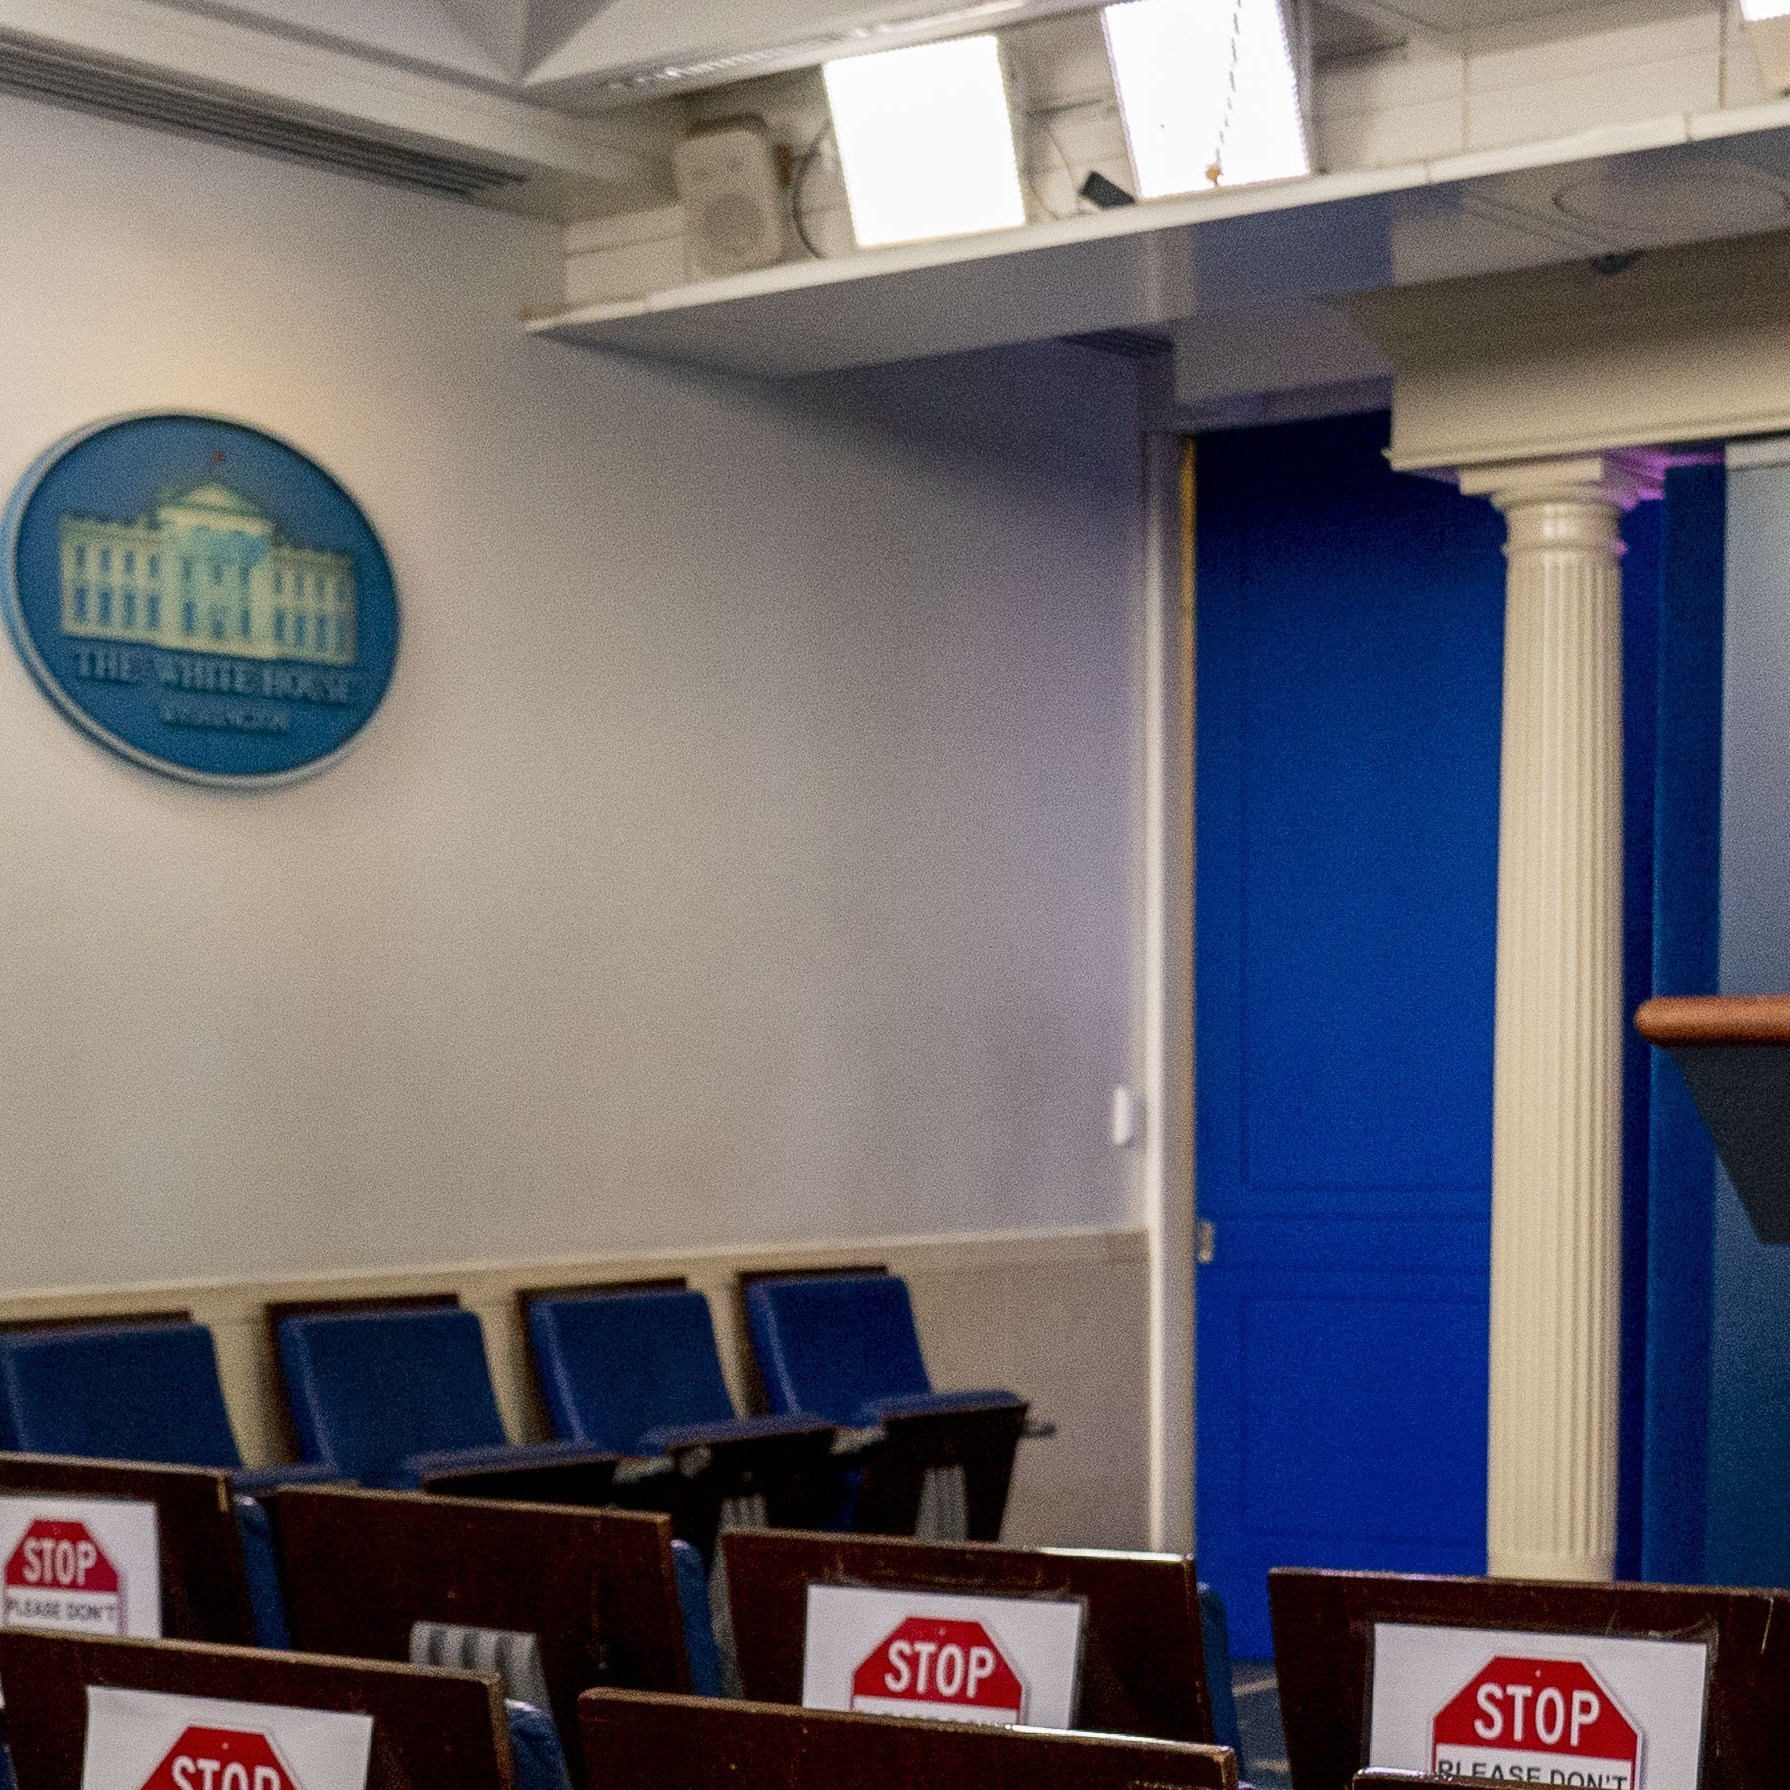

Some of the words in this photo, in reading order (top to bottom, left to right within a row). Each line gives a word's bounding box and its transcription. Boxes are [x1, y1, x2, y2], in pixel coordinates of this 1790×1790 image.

[22, 1537, 97, 1586] STOP
[884, 1639, 995, 1699] STOP
[1474, 1682, 1600, 1747] STOP
